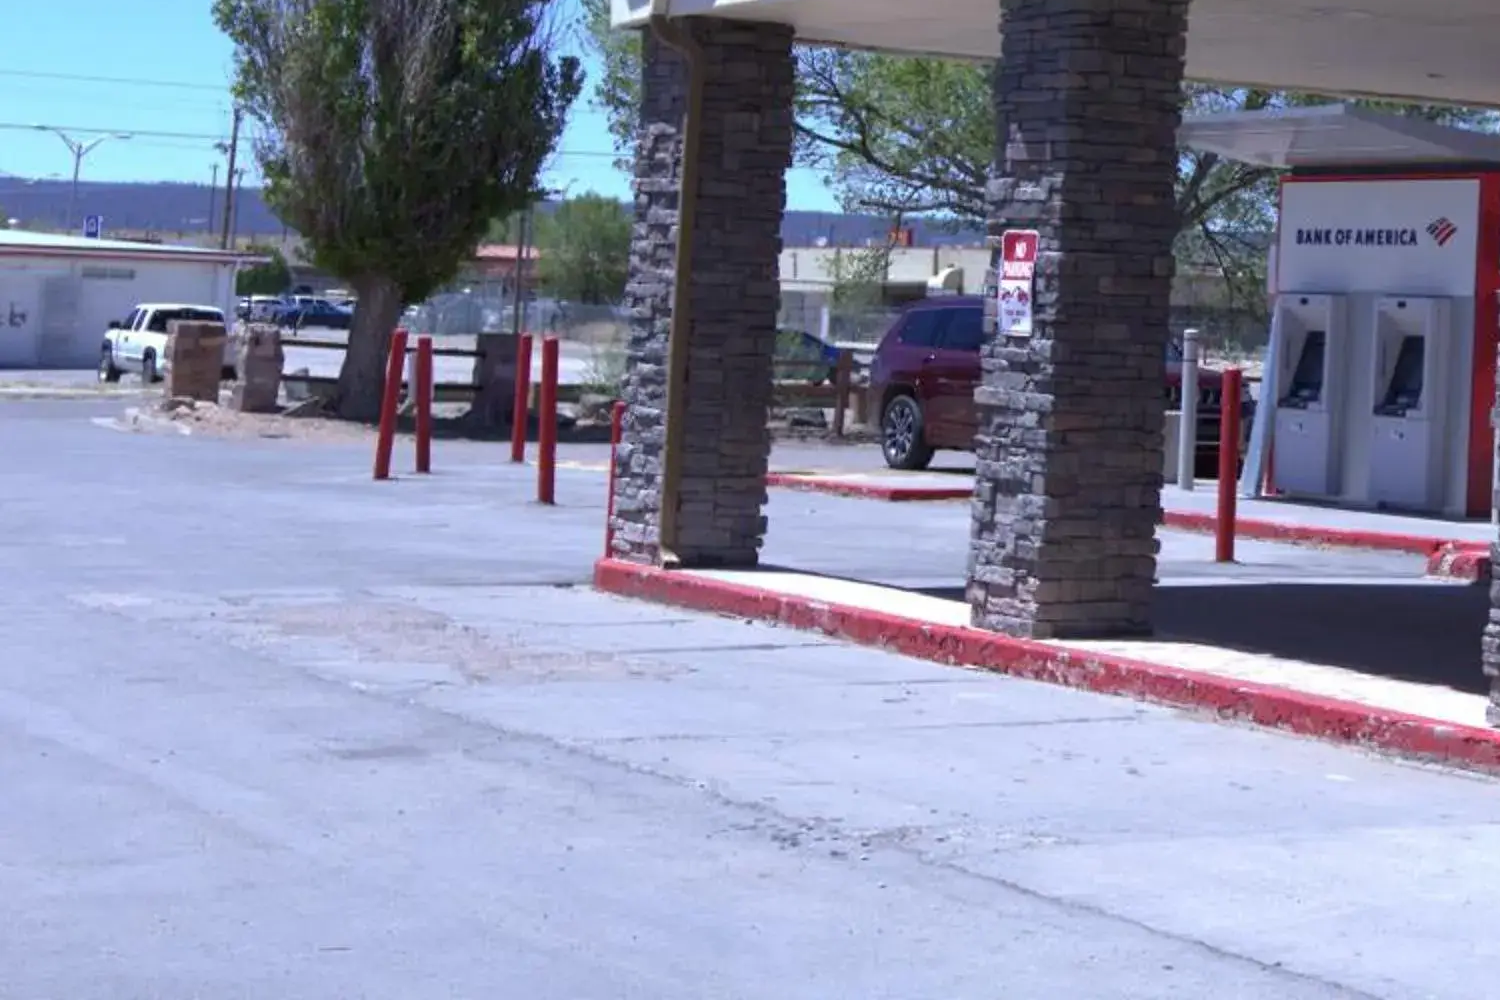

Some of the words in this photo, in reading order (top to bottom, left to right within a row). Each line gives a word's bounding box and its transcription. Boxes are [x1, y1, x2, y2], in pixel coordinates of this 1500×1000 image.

[1296, 228, 1332, 246] BANK
[1334, 229, 1353, 246] OF
[1355, 228, 1418, 246] AMERICA
